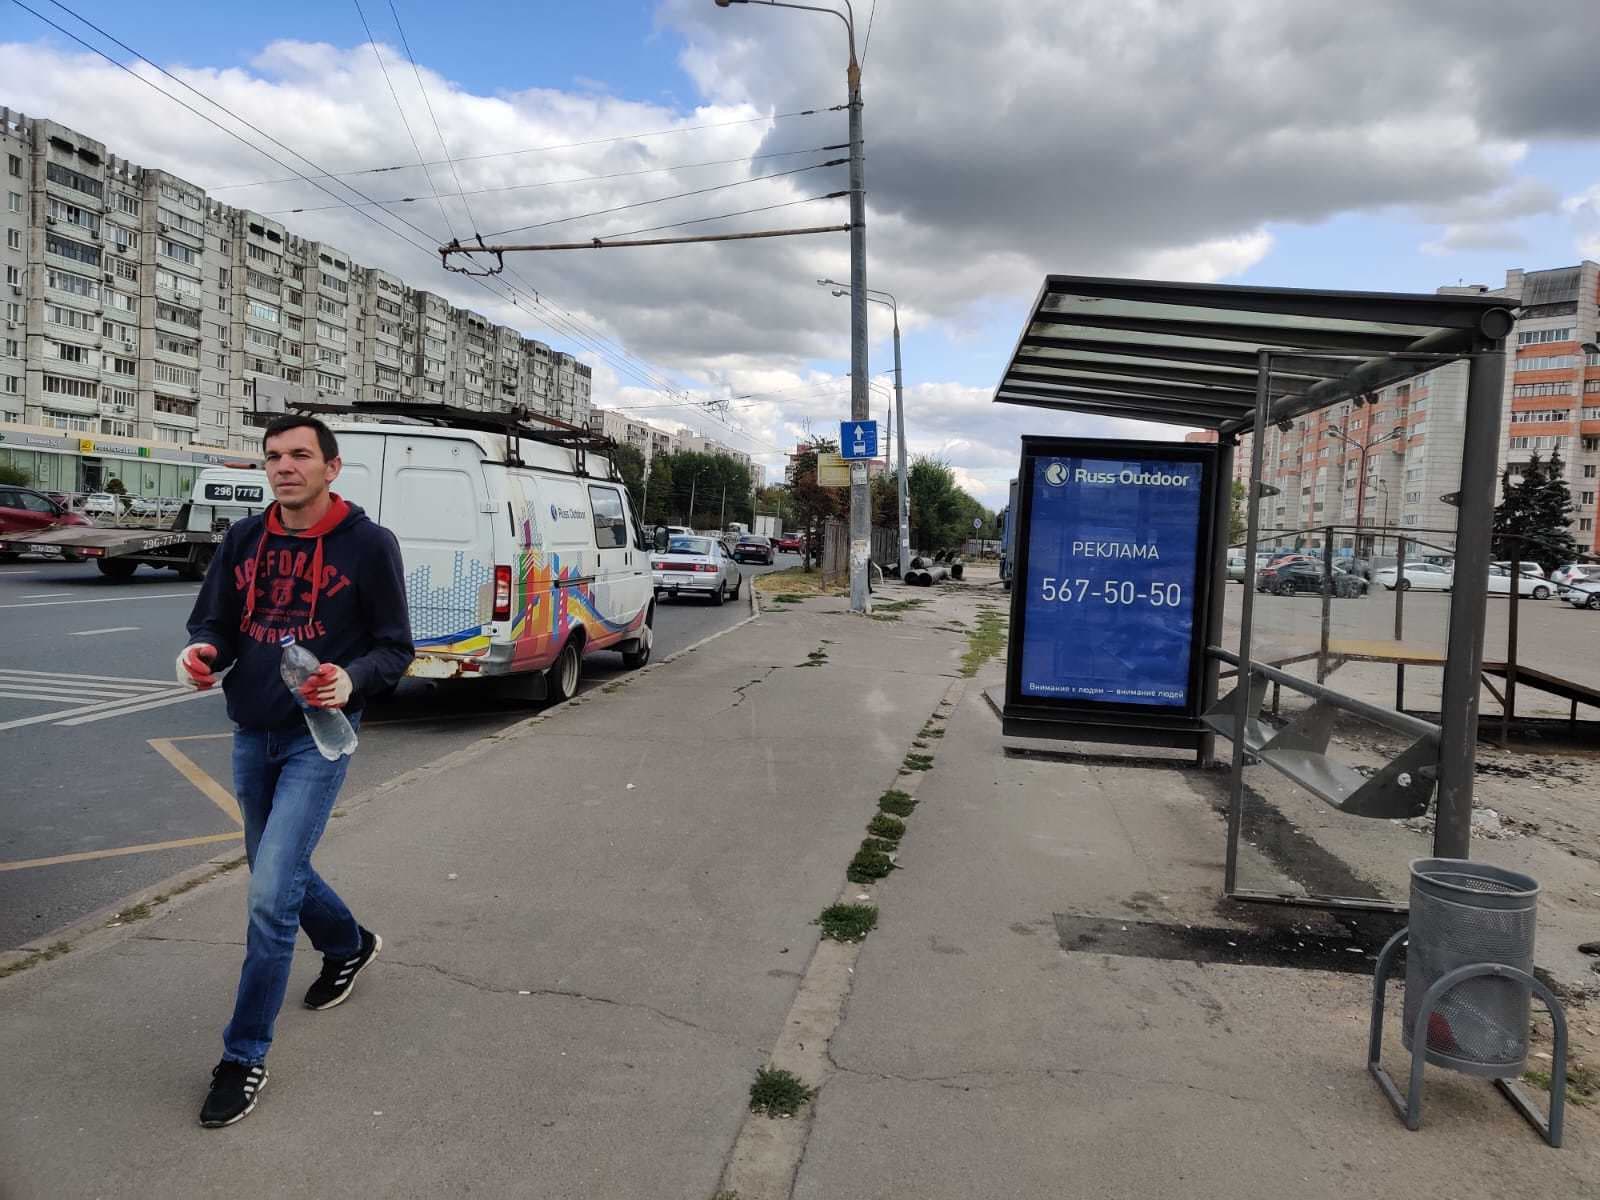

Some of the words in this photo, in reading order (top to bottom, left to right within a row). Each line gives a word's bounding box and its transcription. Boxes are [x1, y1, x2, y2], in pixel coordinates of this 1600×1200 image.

[1075, 468, 1115, 484] Russ
[1119, 470, 1190, 487] Outdoor
[214, 486, 232, 496] 296
[236, 488, 261, 498] 7772
[1072, 541, 1160, 560] РЕКЛАМА
[1042, 578, 1181, 607] 567-50-50
